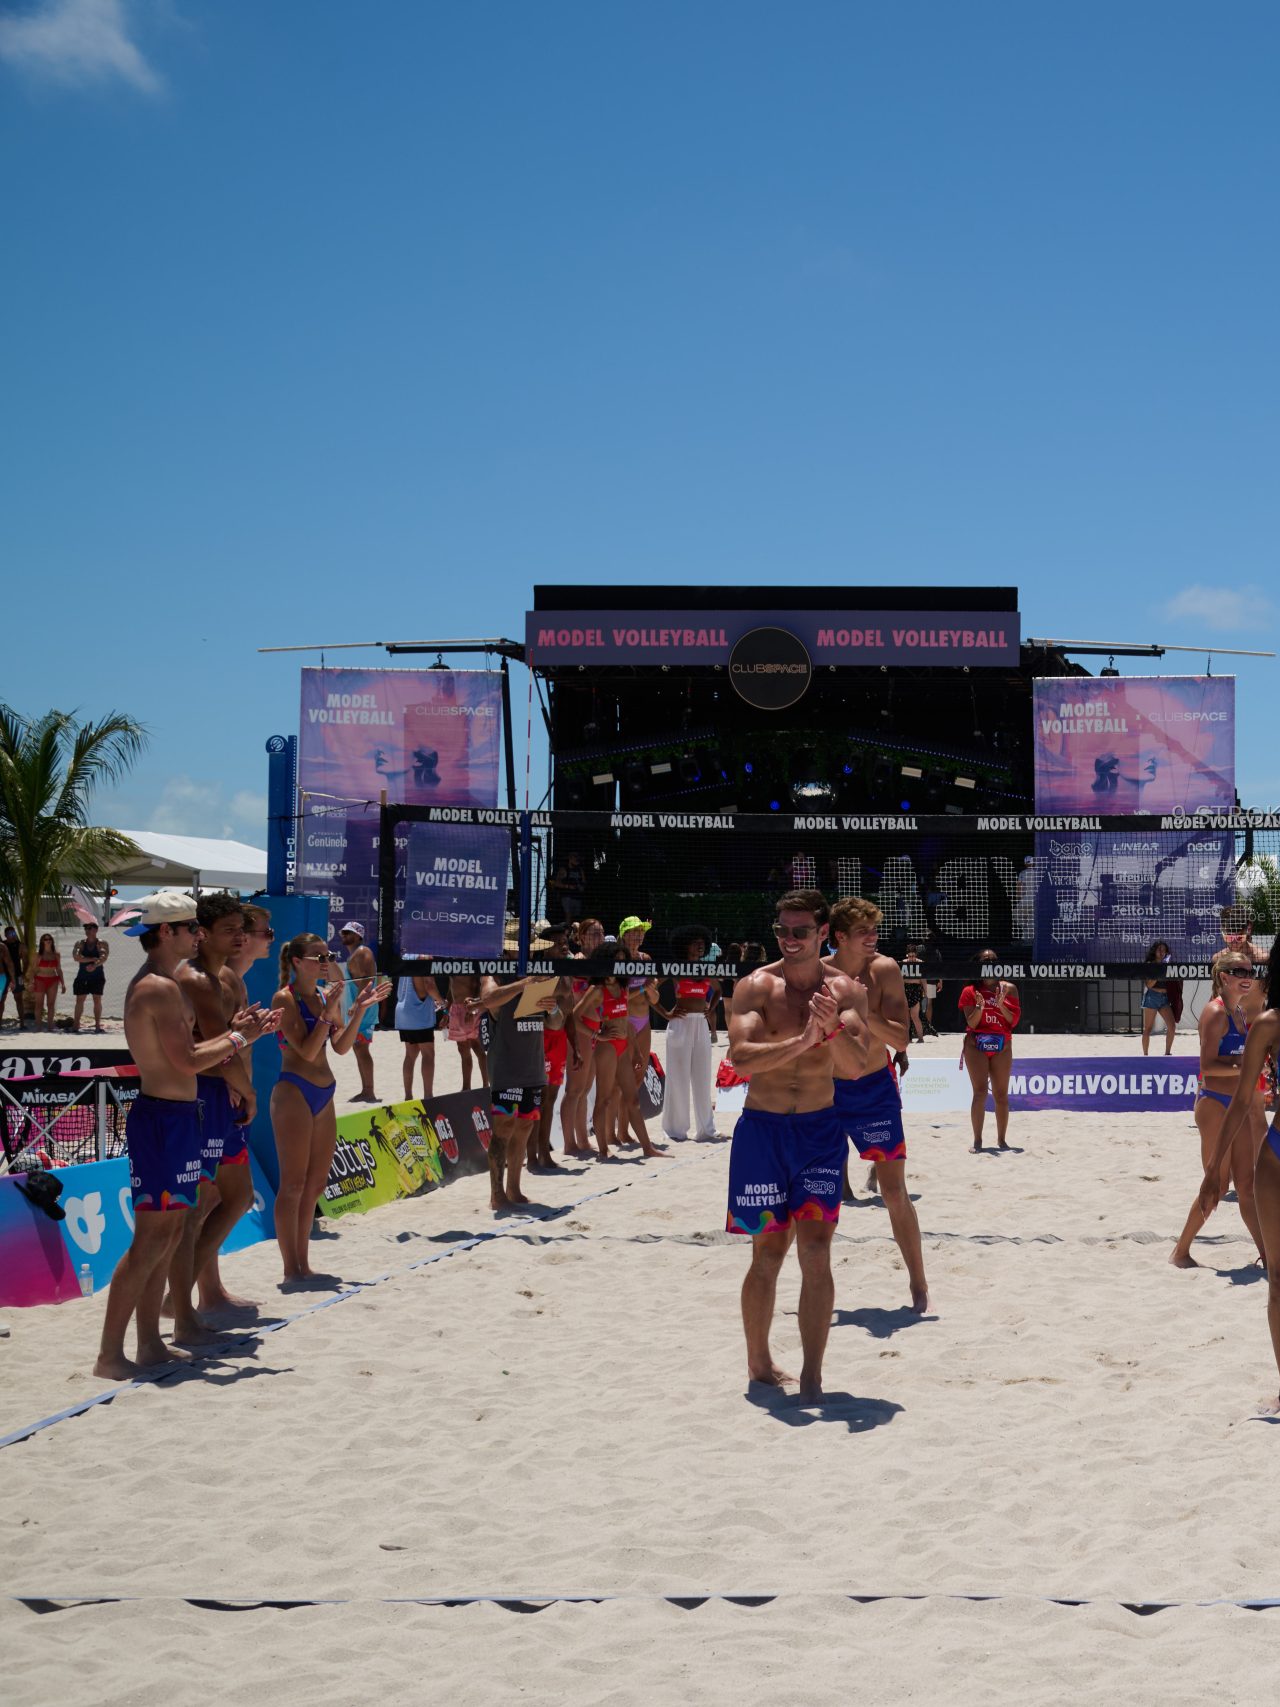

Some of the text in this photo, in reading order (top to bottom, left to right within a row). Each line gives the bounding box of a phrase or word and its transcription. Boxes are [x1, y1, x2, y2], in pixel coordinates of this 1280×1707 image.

[537, 628, 728, 648] MODEL VOLLEYBALL
[816, 629, 1008, 649] MODEL VOLLEYBALL
[731, 662, 808, 675] CLUBSPACE
[327, 693, 378, 709] MODEL
[308, 708, 395, 726] VOLLEYBALL
[415, 706, 494, 717] CLUBSPACE
[1059, 702, 1110, 718] MODEL
[1149, 711, 1228, 722] CLUBSPACE
[1042, 717, 1129, 734] VOLLEYBALL
[429, 808, 552, 825] MODEL VOLLEYALL
[610, 814, 735, 829] MODEL VOLLEYBALL
[793, 816, 918, 831] MODEL VOLLEYBALL
[978, 817, 1102, 831] MODEL VOLLEYBALL
[1160, 816, 1205, 830] MODEL
[307, 834, 348, 849] Centinela
[1112, 842, 1160, 851] LINEAR
[306, 863, 347, 871] NYLON
[433, 857, 482, 873] MODEL
[415, 871, 498, 891] VOLLEYBALL
[410, 911, 495, 925] CLUBSPACE
[430, 960, 555, 976] MODEL VOLLEBALL
[613, 961, 738, 978] MODEL VOLLEYBALL
[981, 964, 1106, 978] MODEL VOLLEYBALL
[1165, 965, 1211, 978] MODEL
[481, 1018, 490, 1045] BOSS
[207, 1138, 224, 1148] MOD
[185, 1159, 201, 1172] MOD
[176, 1170, 201, 1184] VOLLEY
[744, 1182, 779, 1195] MODEL
[803, 1178, 836, 1195] bang
[736, 1192, 787, 1207] VOLLEYBALL
